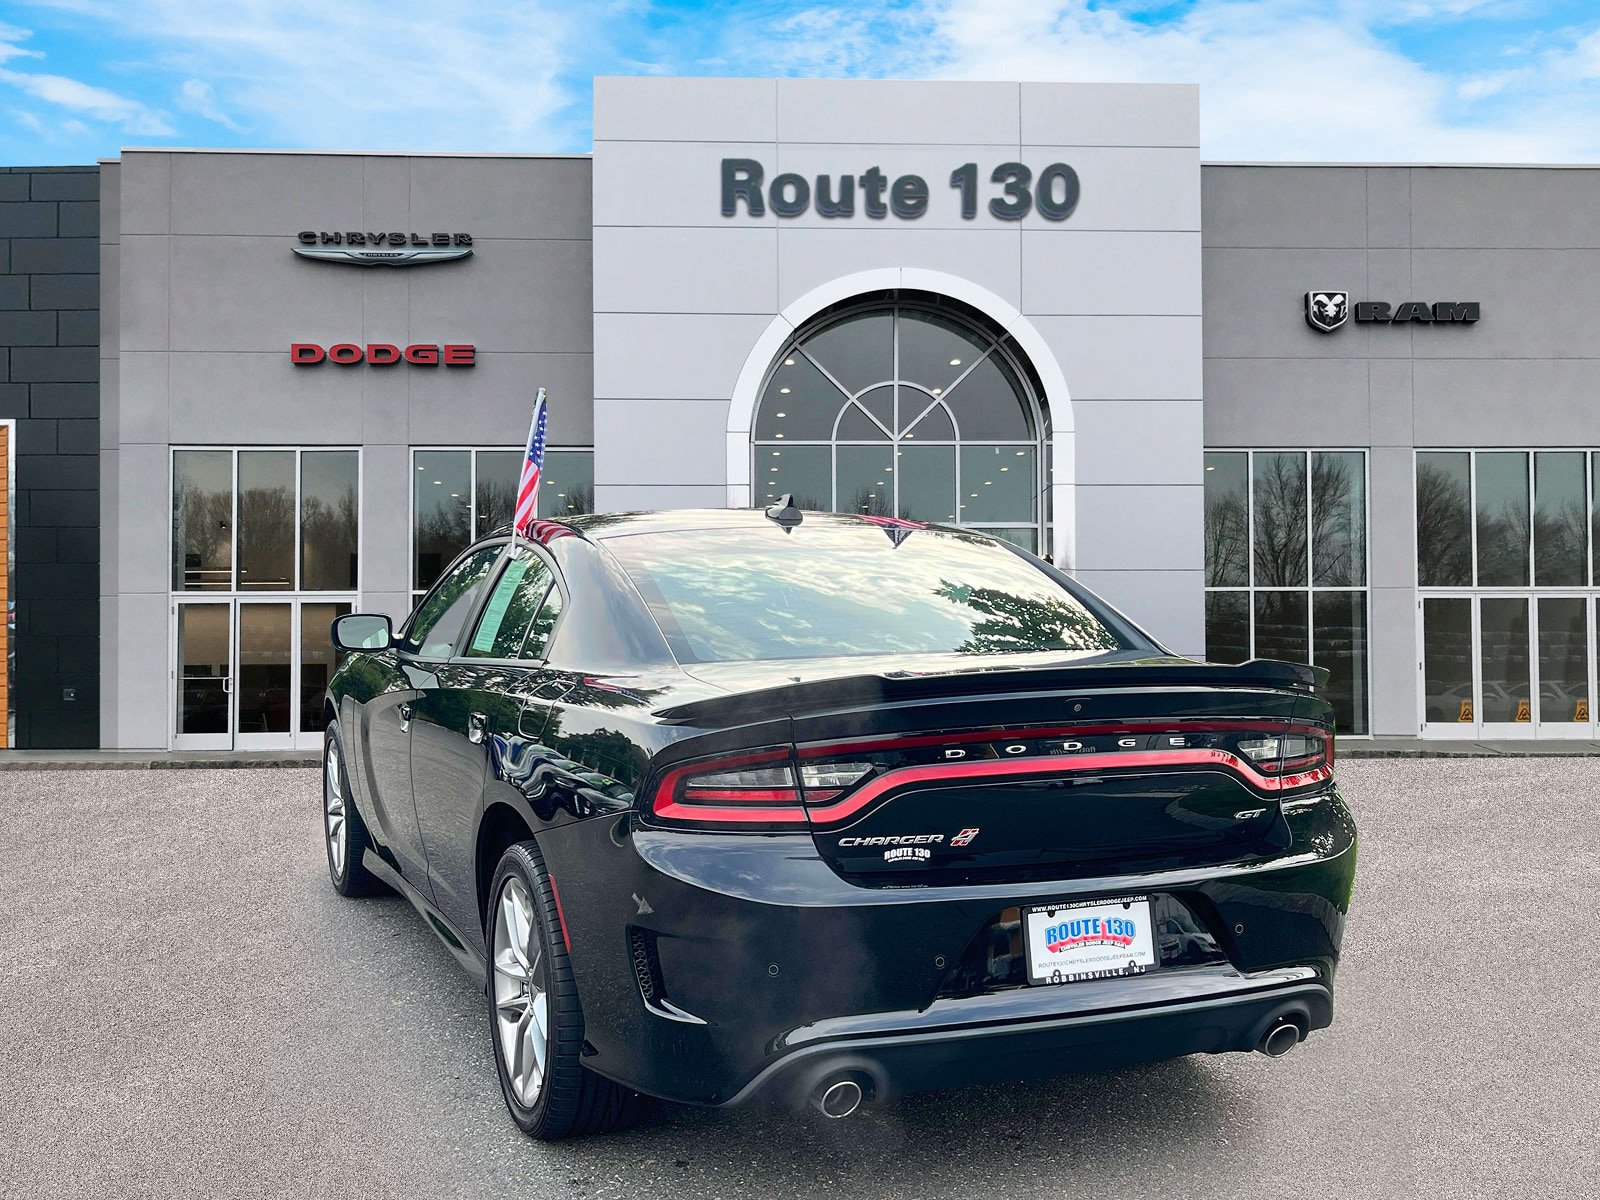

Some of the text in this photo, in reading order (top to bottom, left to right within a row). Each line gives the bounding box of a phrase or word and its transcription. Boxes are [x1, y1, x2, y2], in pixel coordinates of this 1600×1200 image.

[721, 158, 1080, 221] Route 130
[298, 231, 473, 246] CHRYSLER
[1355, 302, 1480, 324] RAM
[291, 343, 476, 366] DODGE
[944, 737, 1187, 760] DODGE
[1234, 808, 1267, 820] GT
[838, 834, 944, 847] CHARGER
[884, 847, 913, 860] ROUTE
[914, 847, 931, 858] 130
[1045, 917, 1136, 946] ROUTE 130
[1133, 966, 1146, 975] NJ
